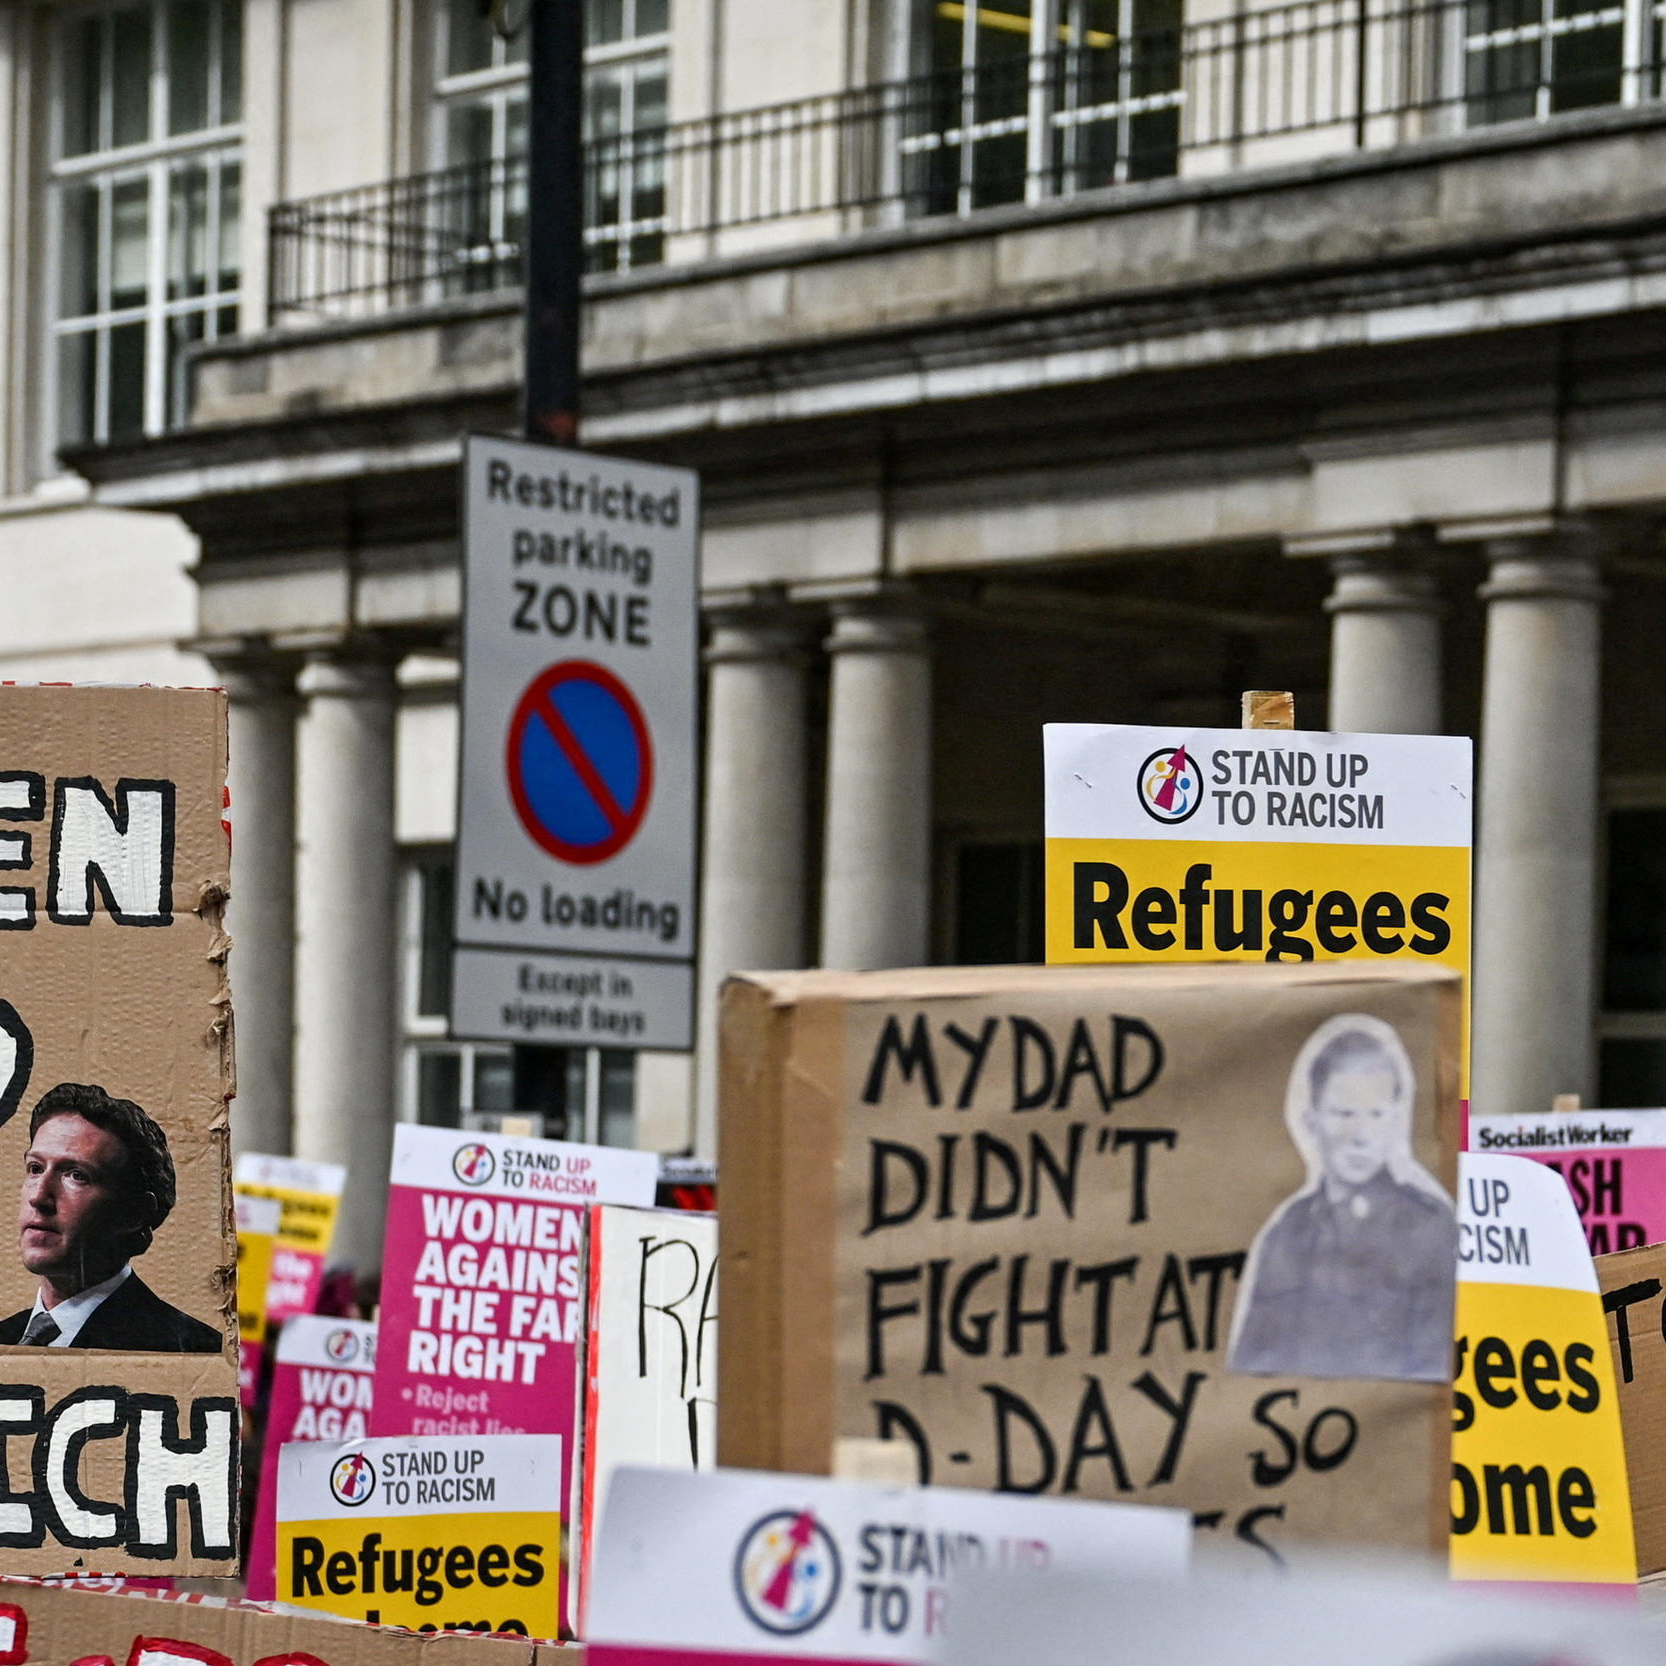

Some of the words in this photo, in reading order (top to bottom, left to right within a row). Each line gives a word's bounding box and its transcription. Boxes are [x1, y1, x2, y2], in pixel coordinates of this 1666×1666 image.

[486, 459, 680, 528] Restricted
[512, 529, 652, 586] parking
[512, 582, 651, 646] ZONE
[1212, 749, 1316, 787] STAND
[1326, 753, 1368, 789] UP
[1212, 790, 1255, 825] TO
[1267, 792, 1384, 829] RACISM
[471, 877, 528, 923] No
[543, 885, 680, 941] loading
[1073, 861, 1451, 962] Refugees
[518, 964, 603, 1000] Except
[611, 966, 631, 994] in
[500, 1005, 583, 1036] signed
[589, 1006, 646, 1037] bays
[862, 1014, 998, 1110] MY
[1012, 1014, 1164, 1113] DAD
[1478, 1125, 1565, 1148] Socialist
[1567, 1122, 1633, 1146] Worker
[501, 1168, 525, 1189] TO
[529, 1173, 598, 1197] RACISM
[502, 1150, 561, 1172] STAND
[566, 1157, 592, 1175] UP
[862, 1122, 1177, 1237] DIDN'T
[421, 1193, 584, 1251] WOMEN
[1468, 1177, 1510, 1218] UP
[413, 1285, 498, 1334] THE
[865, 1253, 1141, 1380] FIGHT
[408, 1331, 546, 1385] RIGHT
[415, 1385, 490, 1416] Reject
[381, 1450, 448, 1478] STAND
[454, 1449, 485, 1474] UP
[1249, 1388, 1359, 1487] SO
[382, 1480, 410, 1505] TO
[416, 1476, 496, 1503] RACISM
[290, 1533, 545, 1606] Refugees
[856, 1583, 911, 1636] TO
